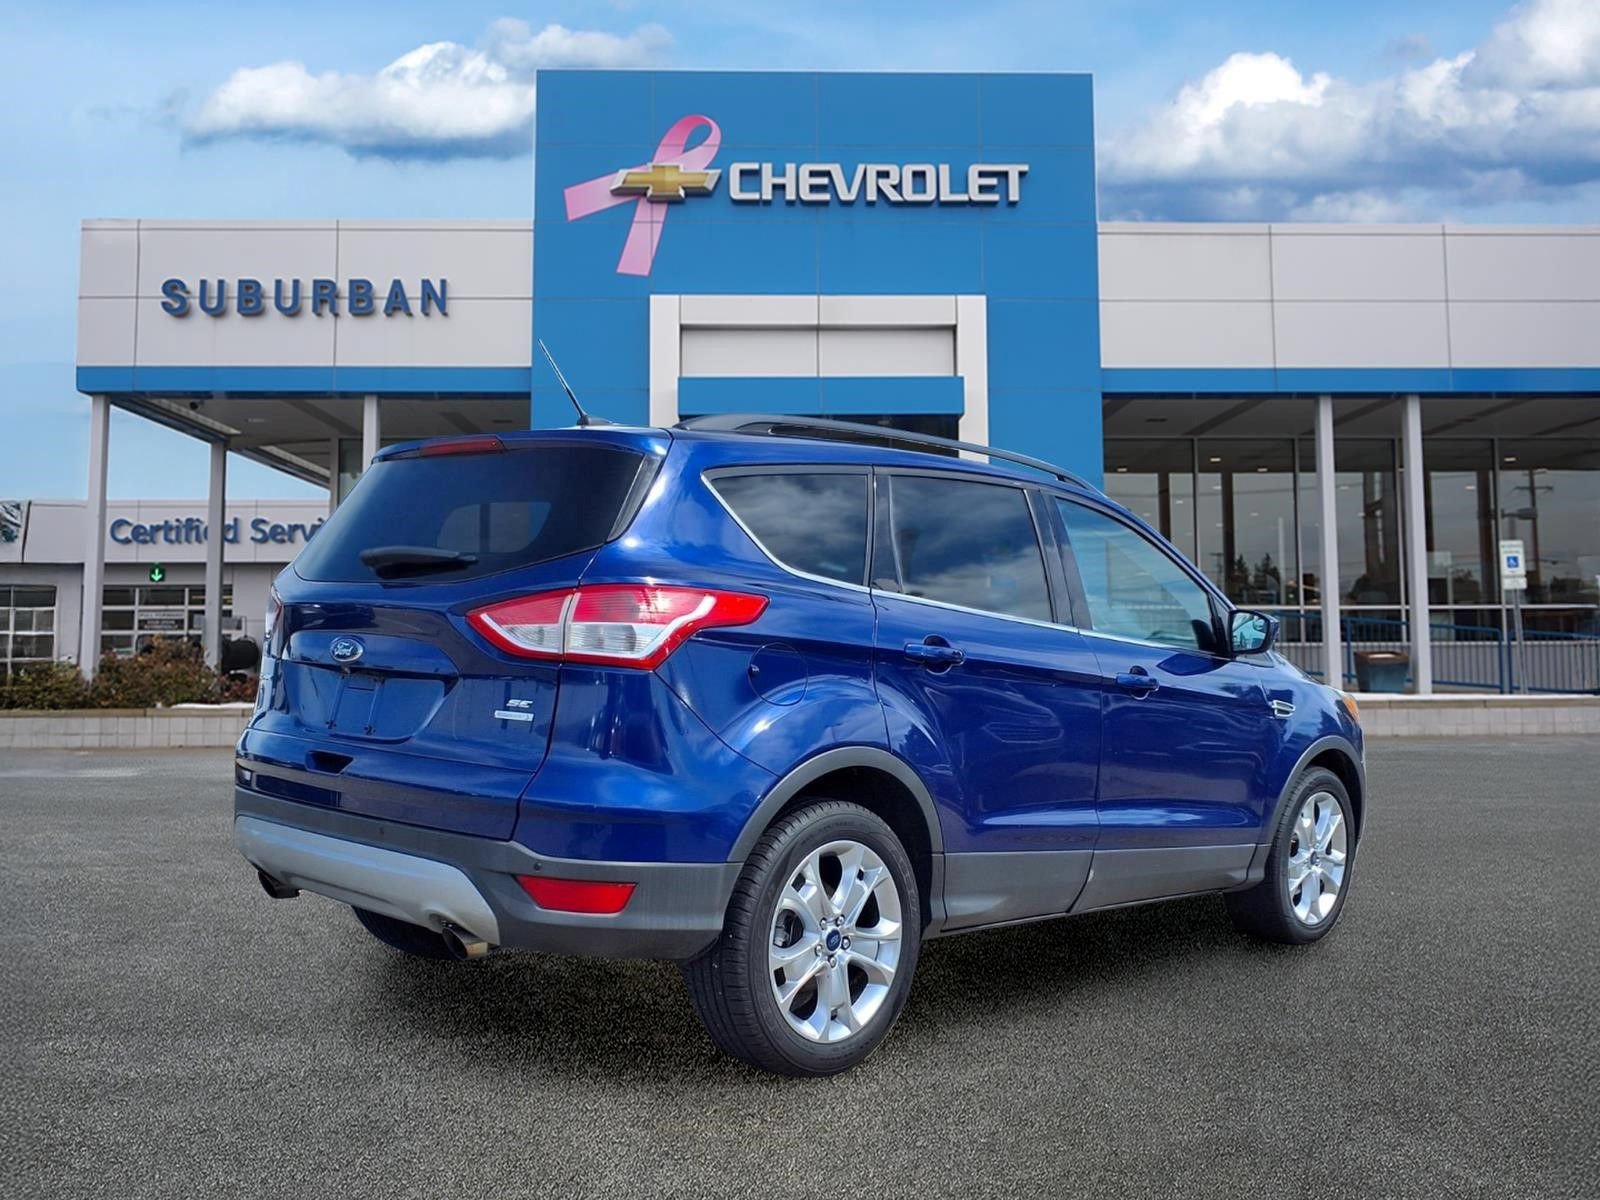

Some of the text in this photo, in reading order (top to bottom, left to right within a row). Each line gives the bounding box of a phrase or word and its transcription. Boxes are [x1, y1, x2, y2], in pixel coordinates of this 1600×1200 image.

[729, 162, 1029, 204] CHEVROLET
[161, 278, 448, 317] SUBURBAN
[110, 517, 240, 545] Certifid
[506, 699, 533, 708] SE
